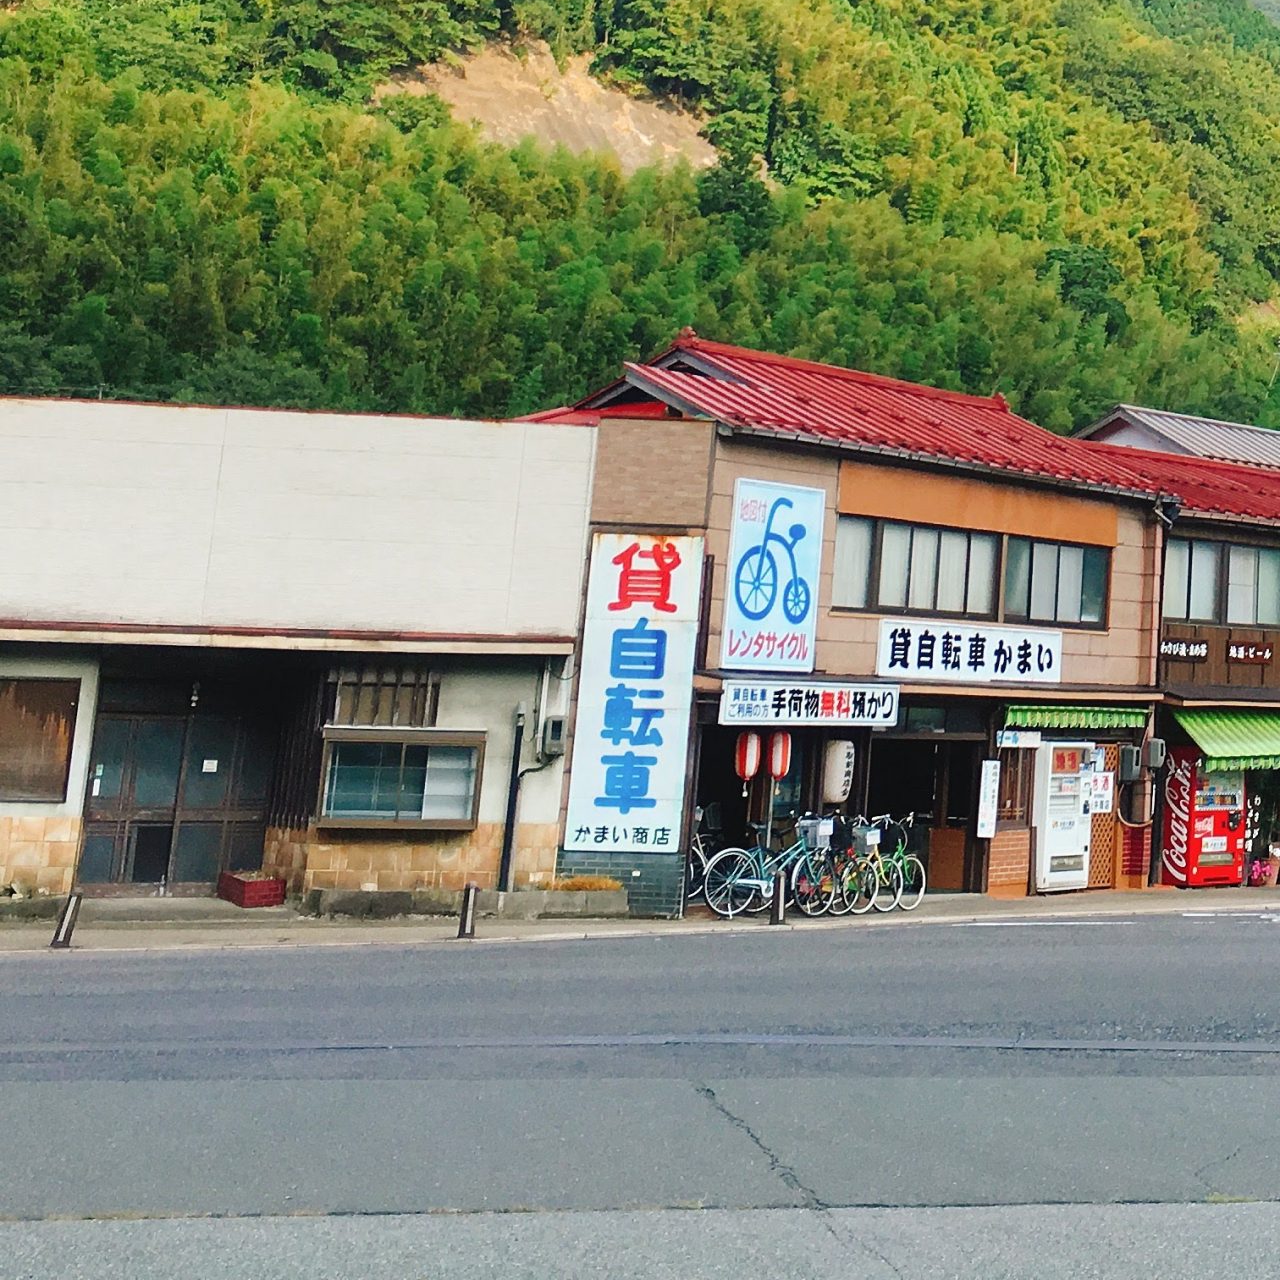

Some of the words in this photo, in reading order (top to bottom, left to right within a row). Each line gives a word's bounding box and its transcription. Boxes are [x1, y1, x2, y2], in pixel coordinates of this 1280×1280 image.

[728, 629, 809, 661] レンタサイクル
[594, 542, 683, 815] 貸自転車
[728, 703, 769, 718] ご利用の方
[733, 688, 767, 702] 貸自転車
[771, 688, 895, 719] 手荷物無料預かり
[1162, 752, 1192, 882] Coca-Cola
[574, 824, 671, 846] かまい商店
